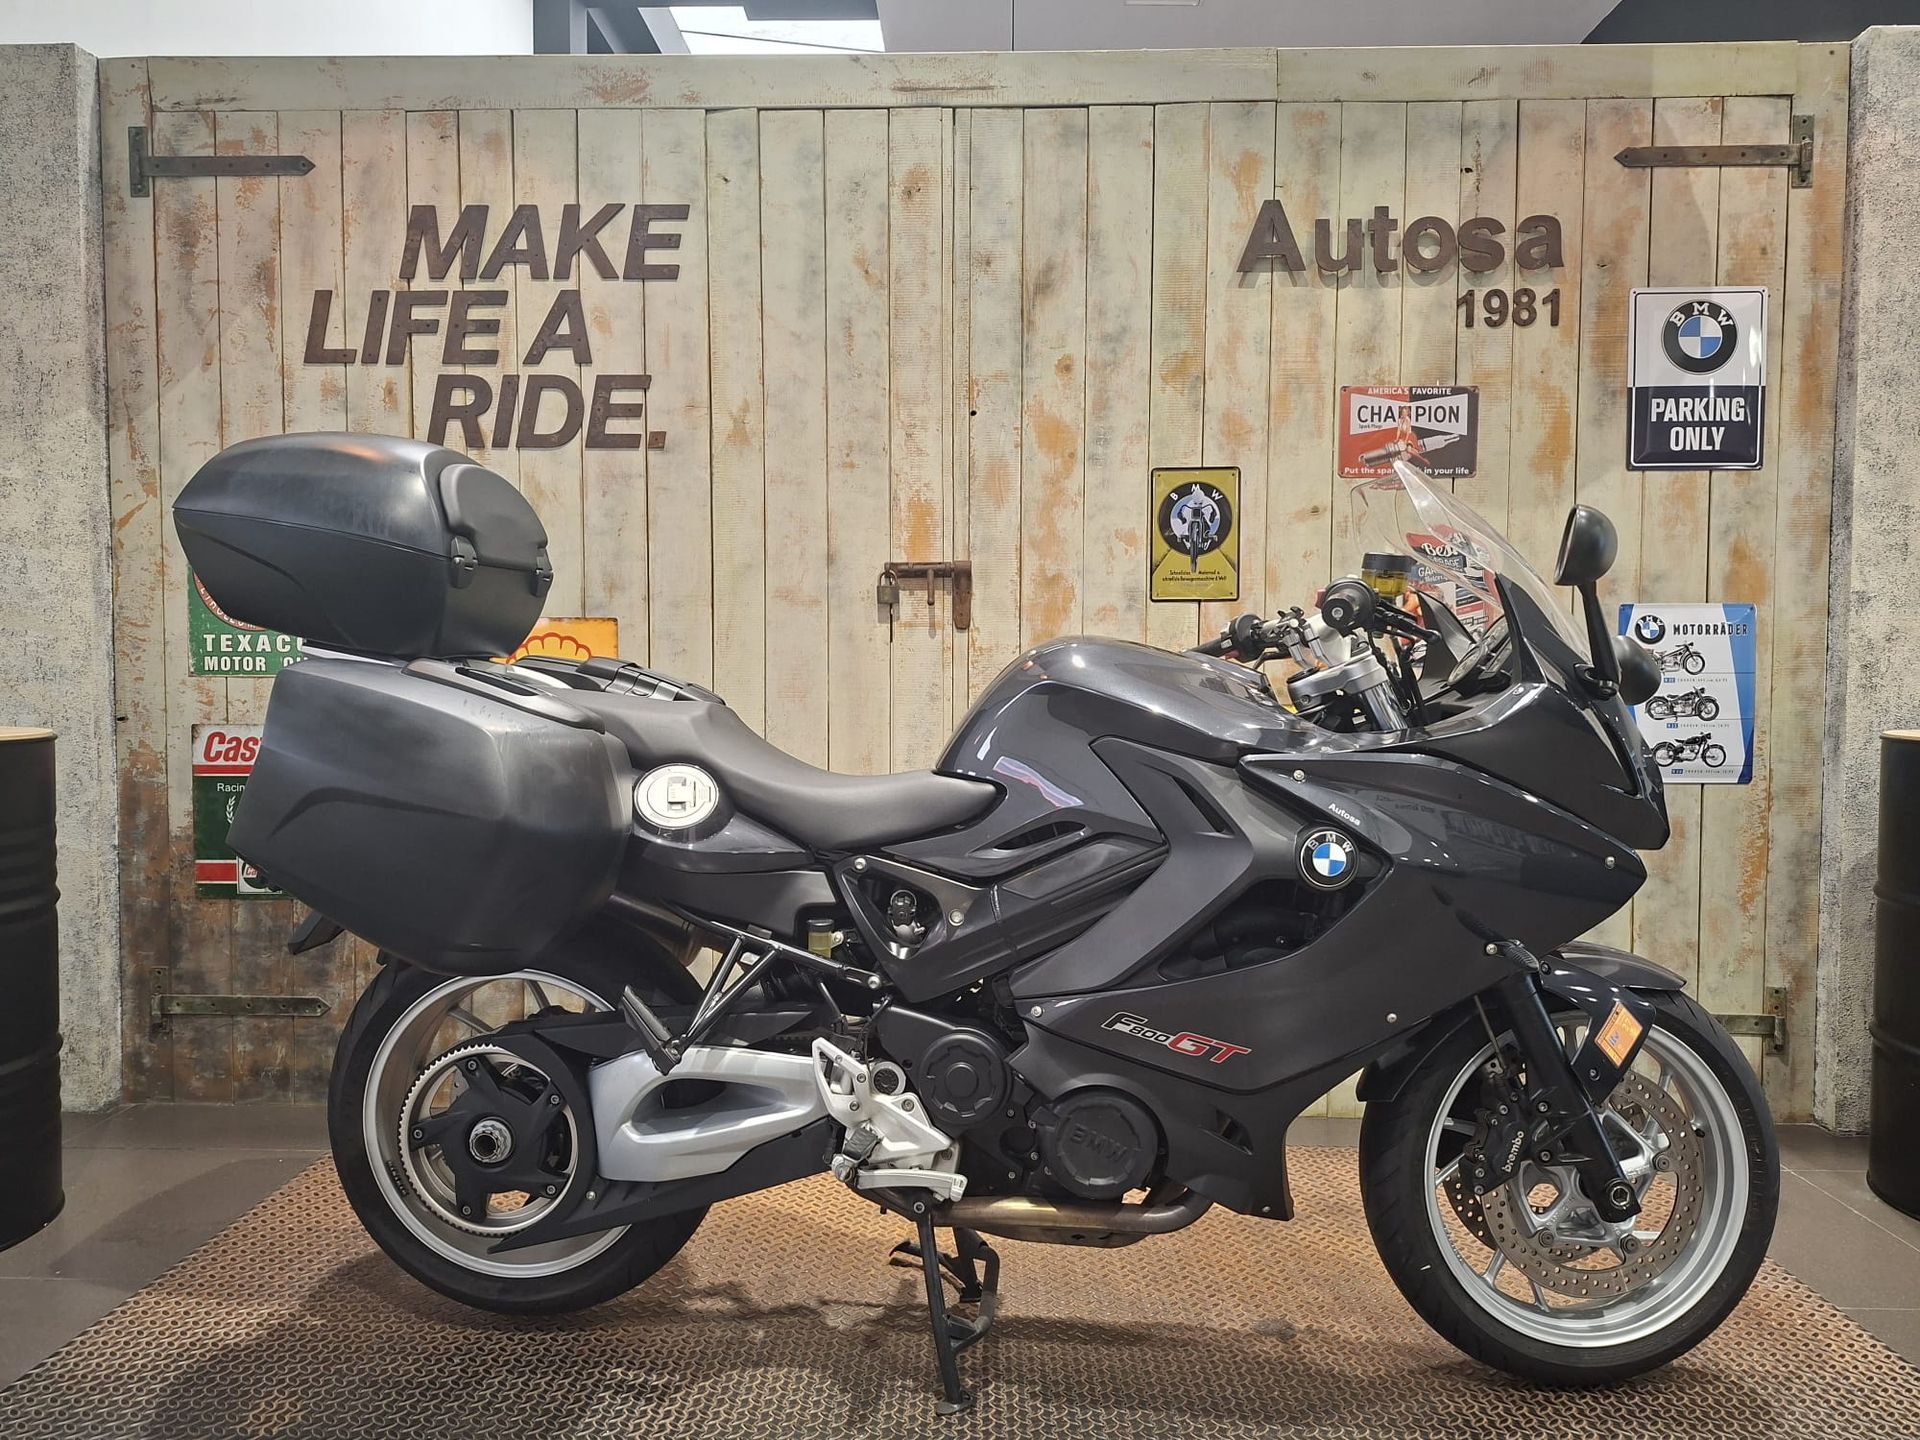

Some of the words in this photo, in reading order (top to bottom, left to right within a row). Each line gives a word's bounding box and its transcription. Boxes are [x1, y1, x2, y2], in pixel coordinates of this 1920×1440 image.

[399, 203, 690, 280] MAKE
[1236, 199, 1564, 273] Autosa
[1457, 287, 1561, 328] 1981
[1669, 302, 1734, 328] BMW
[303, 290, 509, 365] LIFE
[522, 289, 593, 365] A
[1367, 387, 1409, 395] AMERICA'S
[1412, 387, 1452, 395] FAVORITE
[427, 374, 667, 450] RIDE.
[1650, 397, 1745, 422] PARKING
[1669, 426, 1726, 451] ONLY
[1361, 466, 1375, 474] the
[1376, 467, 1394, 476] spar
[1434, 468, 1454, 476] your
[1169, 484, 1223, 501] BMW
[204, 656, 266, 671] MOTOR
[203, 731, 262, 763] Cas
[1328, 803, 1361, 826] Autosa
[1308, 833, 1353, 853] BMW
[1501, 1130, 1525, 1173] brembo
